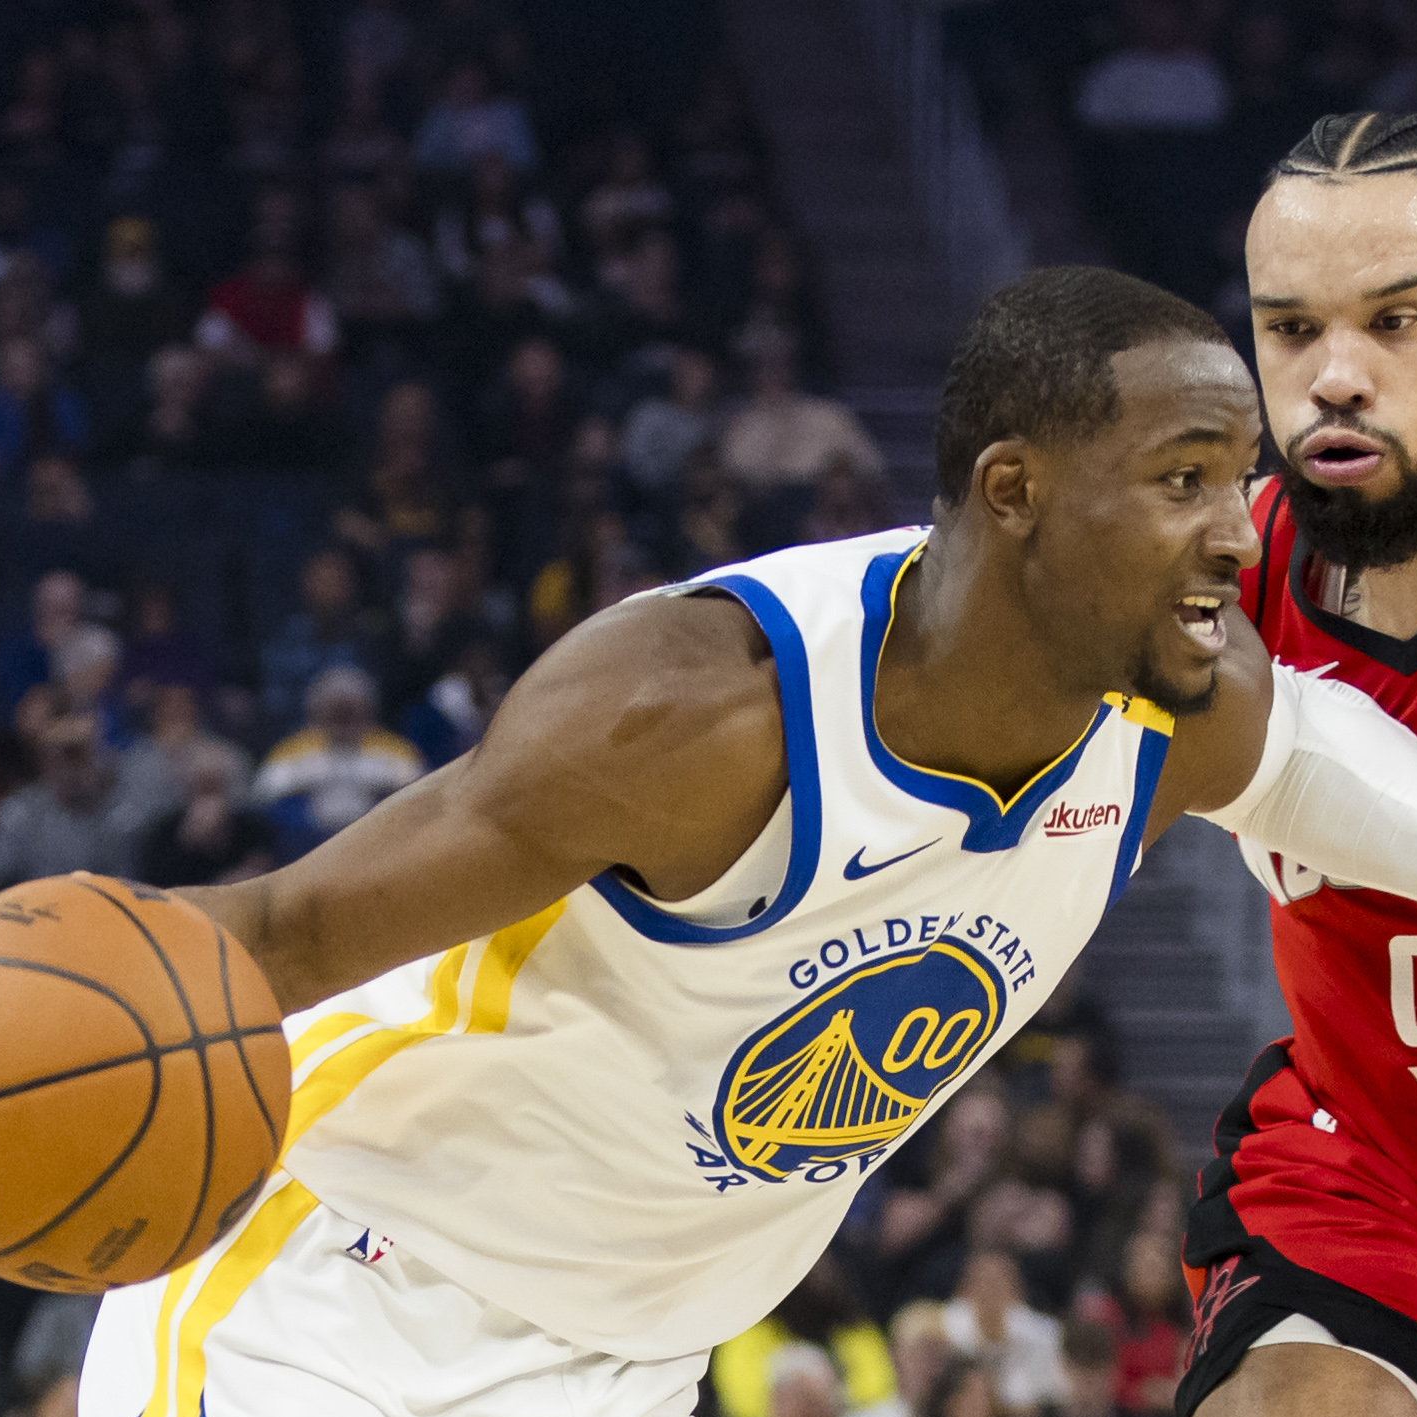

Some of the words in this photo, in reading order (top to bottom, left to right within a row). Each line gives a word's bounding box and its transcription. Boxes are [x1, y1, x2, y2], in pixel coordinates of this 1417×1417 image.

[1043, 800, 1121, 831] akuten
[966, 914, 1035, 993] STATE
[881, 1006, 982, 1074] 00
[683, 1109, 888, 1193] WAROR
